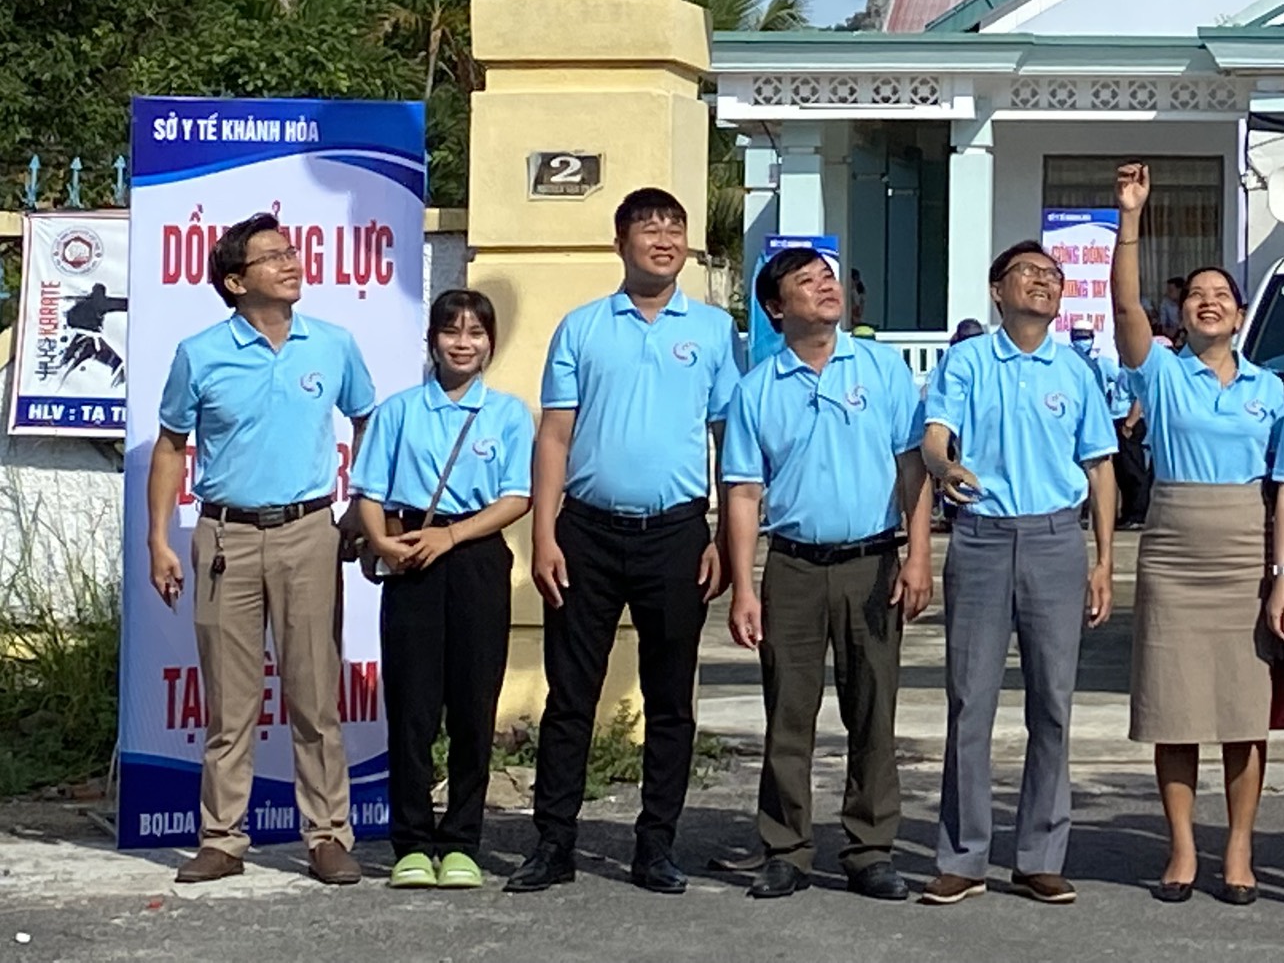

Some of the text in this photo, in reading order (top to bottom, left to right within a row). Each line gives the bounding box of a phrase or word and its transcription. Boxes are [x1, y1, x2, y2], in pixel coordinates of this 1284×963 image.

[153, 111, 178, 141] SỞ
[182, 119, 193, 141] Y
[197, 112, 218, 141] TẾ
[550, 156, 582, 183] 2
[336, 219, 394, 299] LỰC
[39, 281, 60, 336] KARATE
[28, 403, 65, 420] HLV
[140, 811, 196, 837] BQLDA
[255, 801, 294, 830] TỈNH
